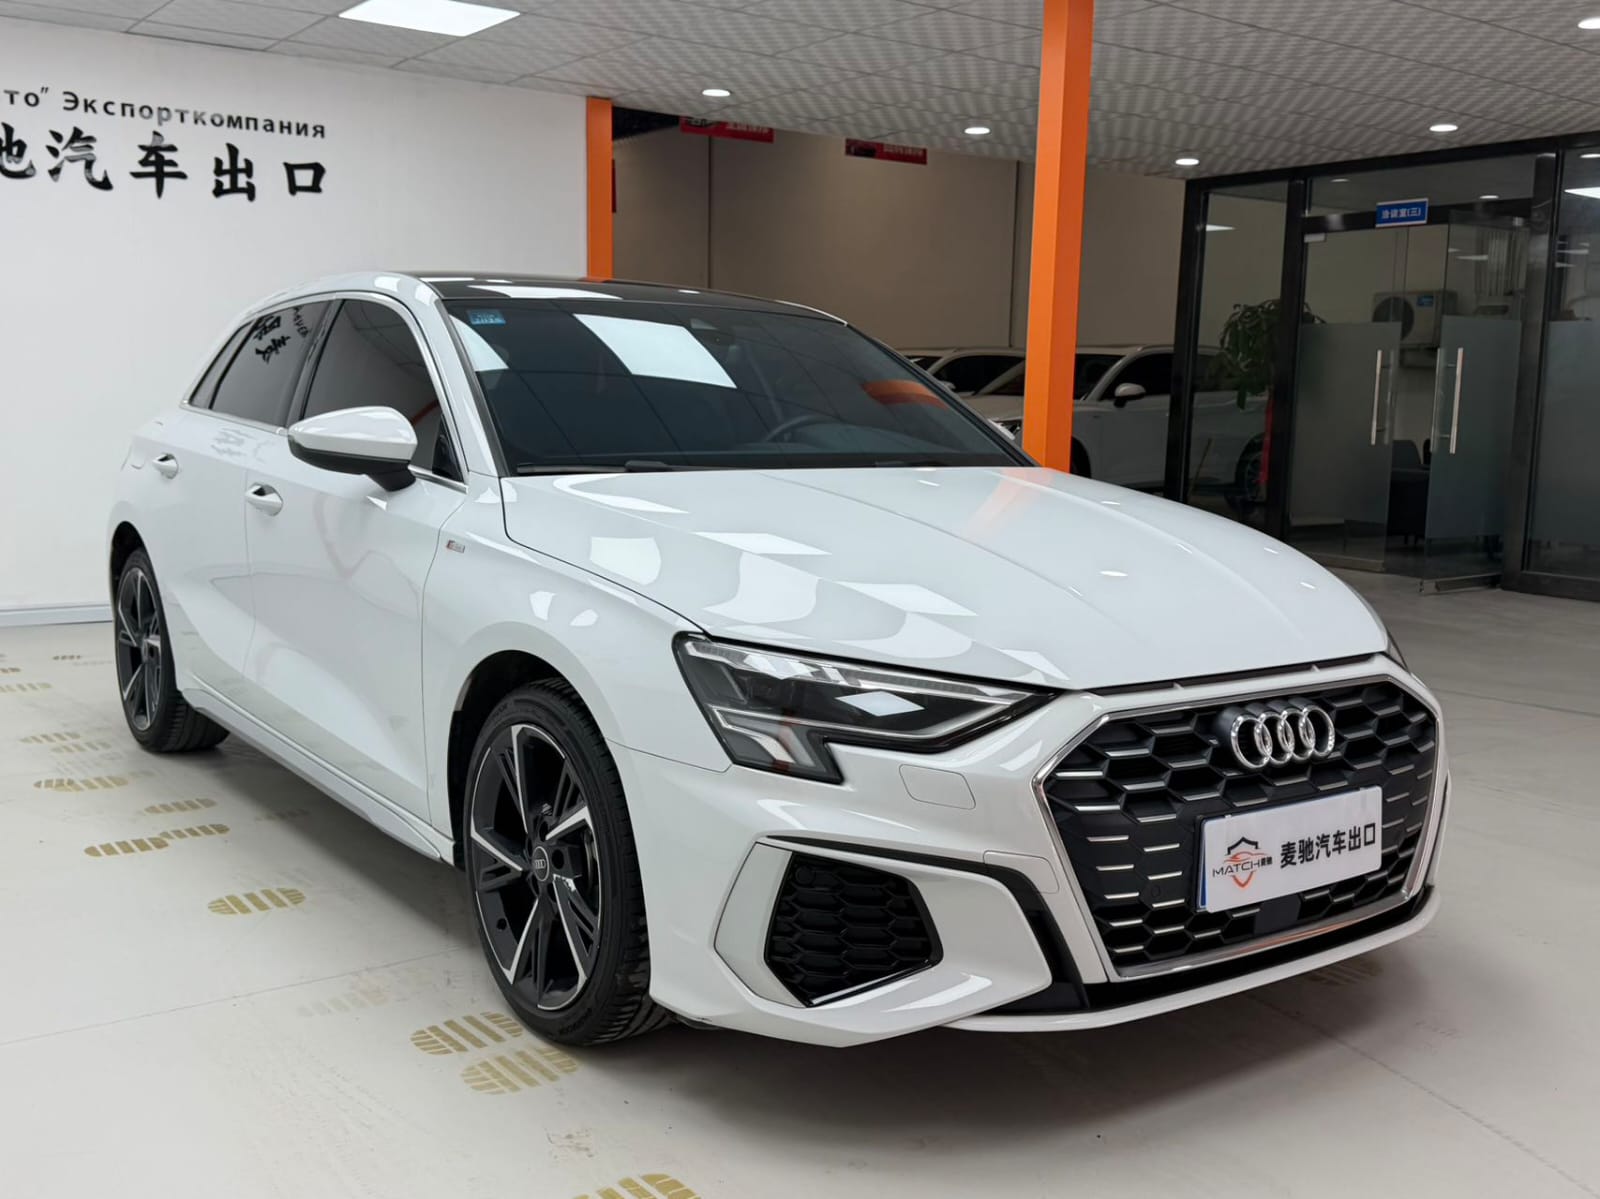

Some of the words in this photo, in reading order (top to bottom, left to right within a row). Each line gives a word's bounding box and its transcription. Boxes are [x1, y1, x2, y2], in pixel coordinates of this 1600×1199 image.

[62, 91, 326, 139] Экспорткомпания
[1212, 859, 1260, 878] MATCH
[1280, 822, 1377, 869] 麦驰汽车出口
